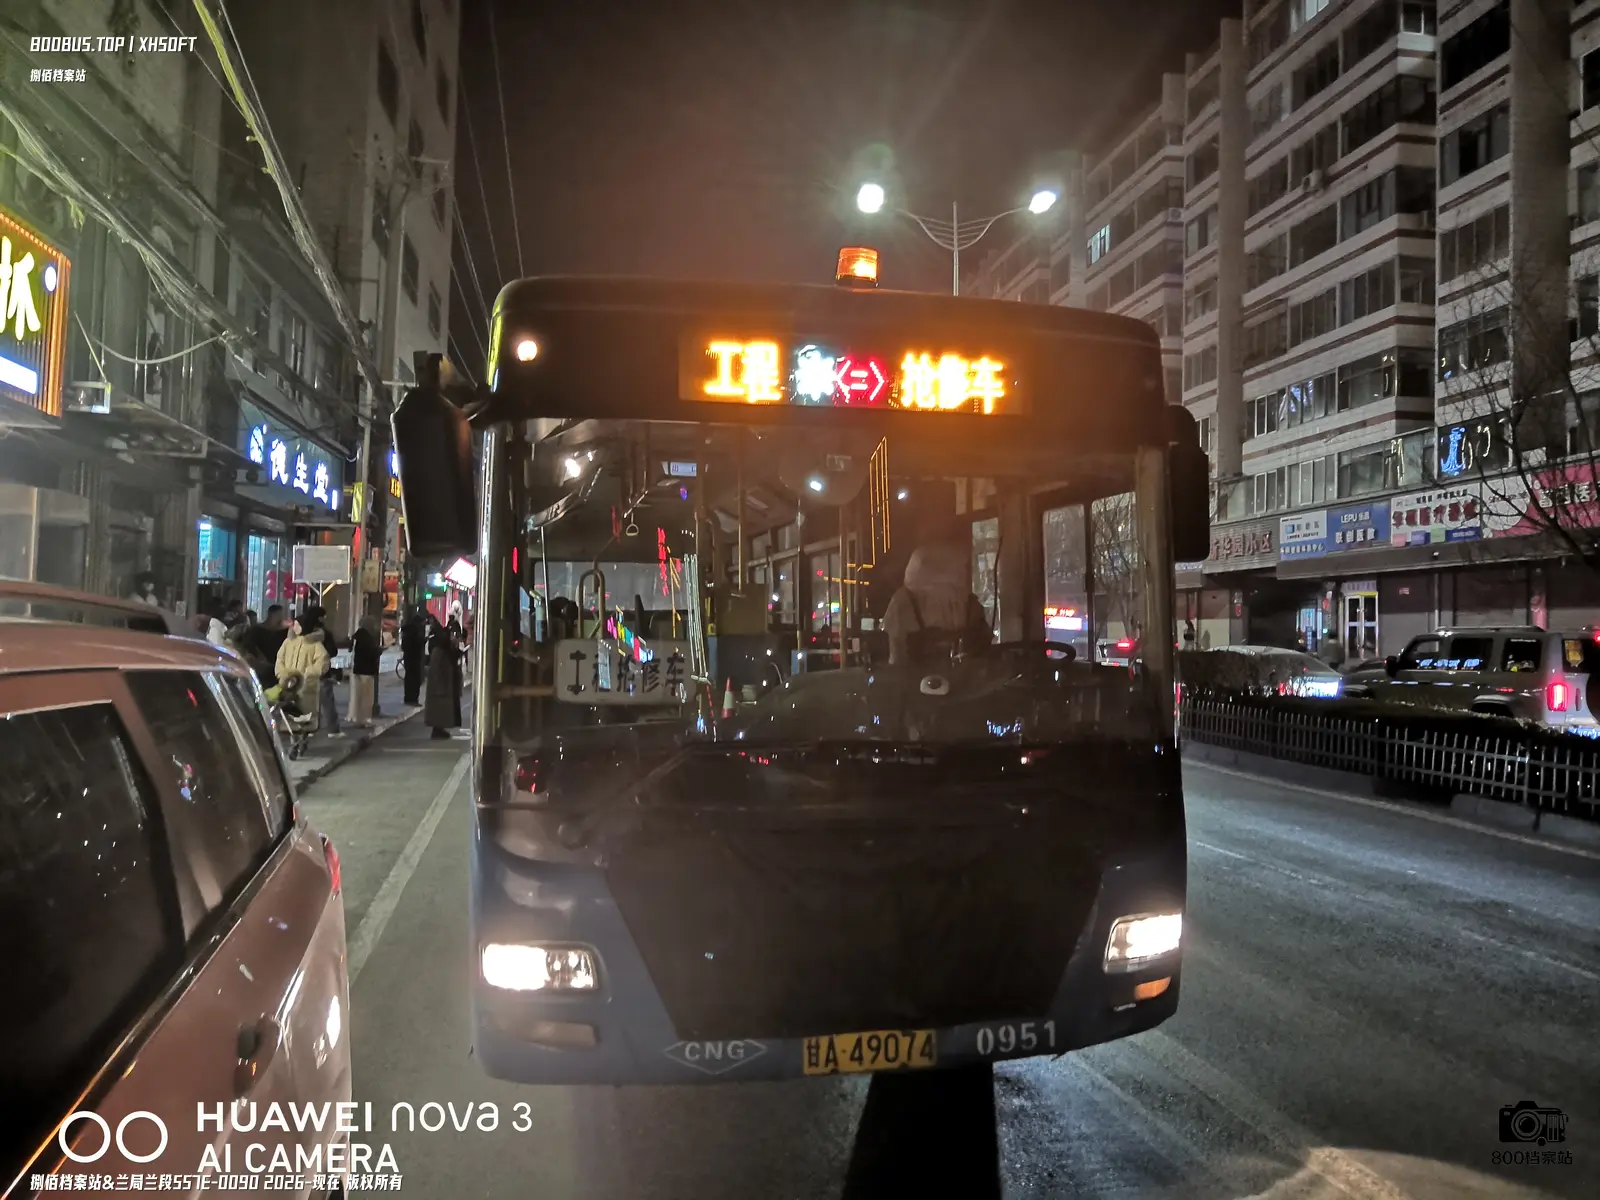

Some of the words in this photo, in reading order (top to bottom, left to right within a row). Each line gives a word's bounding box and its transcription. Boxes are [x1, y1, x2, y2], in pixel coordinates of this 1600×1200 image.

[703, 341, 782, 403] 工程
[684, 1040, 746, 1061] CNG
[976, 1020, 1057, 1056] 0951
